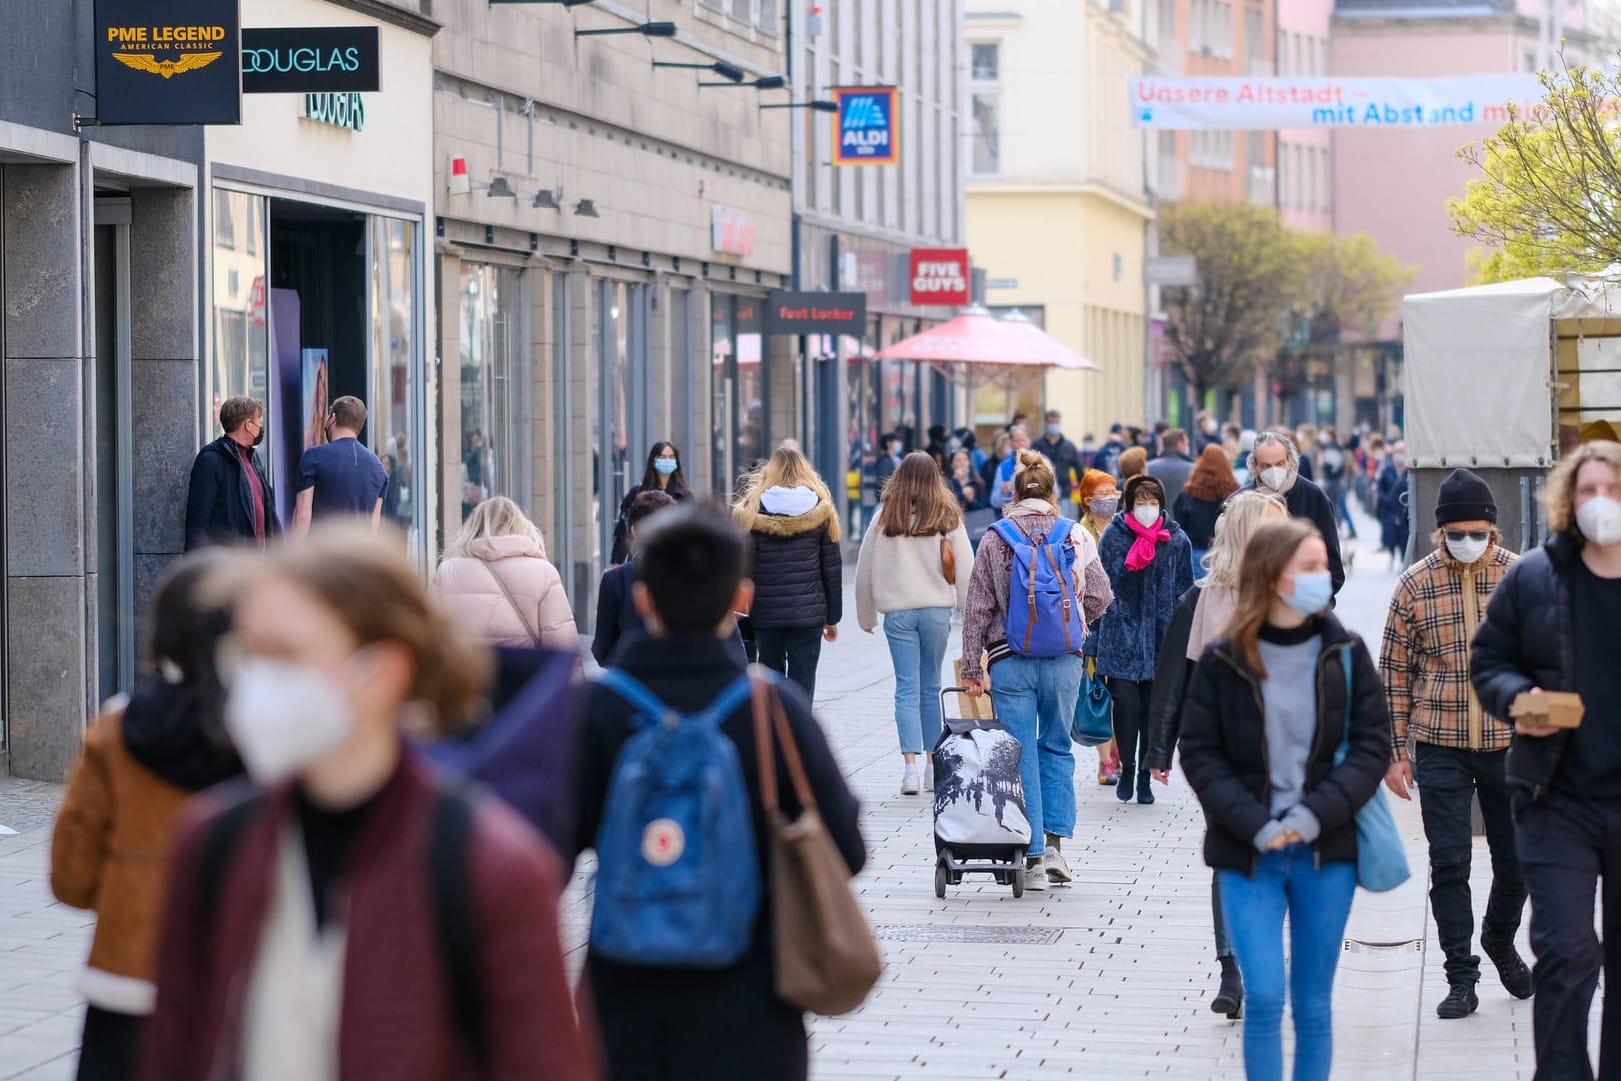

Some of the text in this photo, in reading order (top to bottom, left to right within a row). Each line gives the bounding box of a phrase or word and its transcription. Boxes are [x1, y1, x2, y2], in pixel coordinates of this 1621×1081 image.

[108, 26, 225, 41] PME LEGEND
[120, 42, 214, 50] AMERICAN CLASSIC
[159, 63, 175, 71] PME
[242, 47, 360, 72] DOUGLAS
[1138, 81, 1229, 102] Unsere
[1237, 81, 1344, 104] Altstadt
[1313, 102, 1355, 124] mit
[1363, 101, 1474, 124] Abstand
[843, 130, 888, 146] ALDI
[918, 262, 960, 277] FIVE
[913, 277, 966, 292] GUYS
[780, 306, 855, 320] Foot Locker
